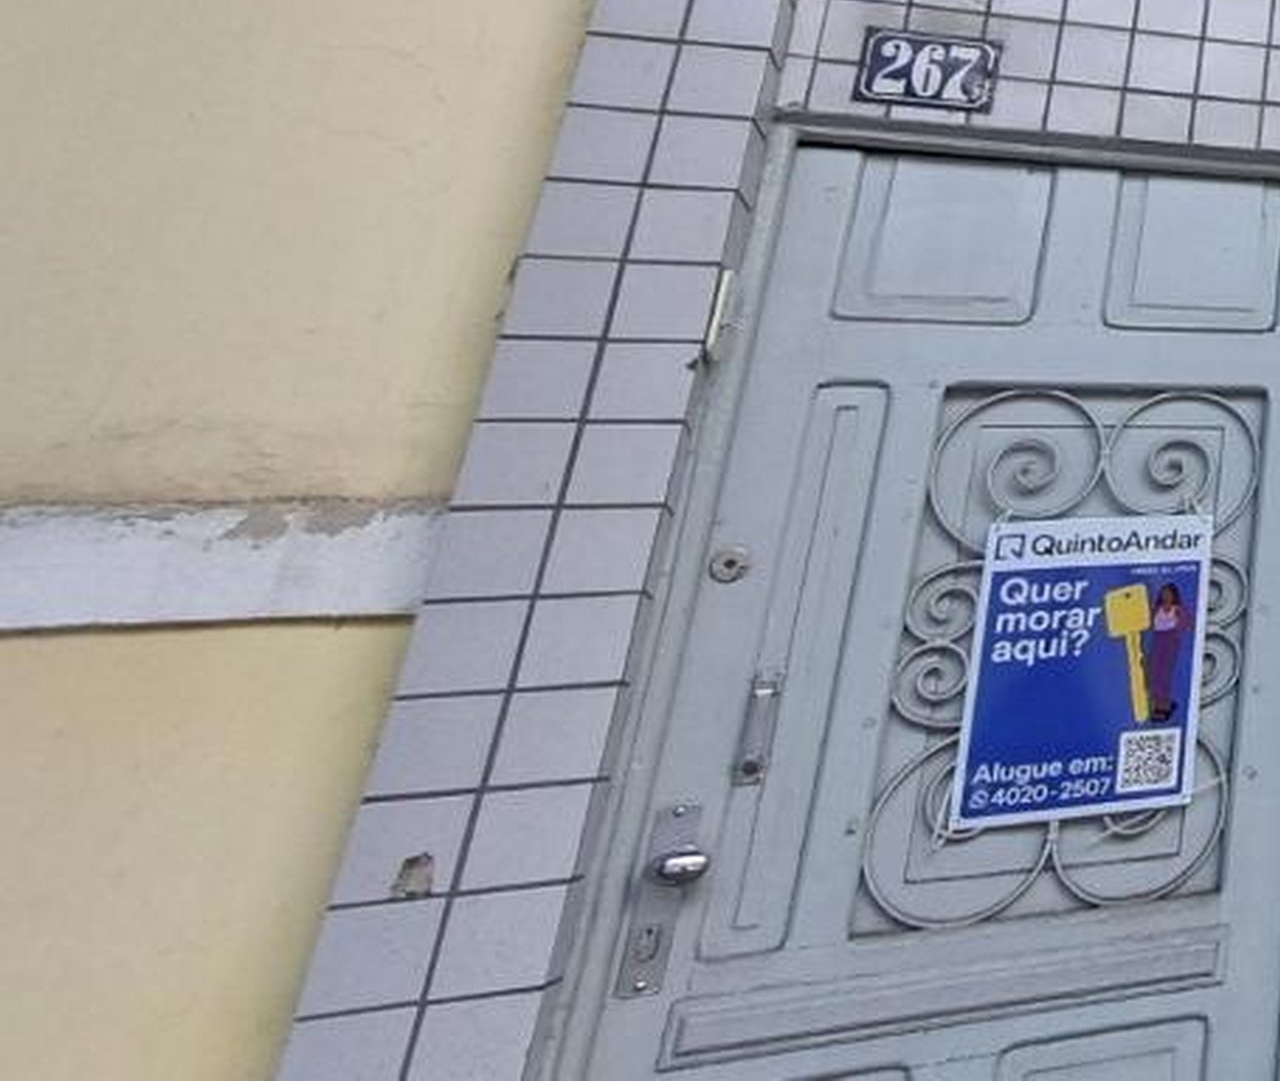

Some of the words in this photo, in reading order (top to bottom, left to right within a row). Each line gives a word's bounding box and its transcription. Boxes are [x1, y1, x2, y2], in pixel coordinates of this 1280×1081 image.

[871, 39, 981, 100] 267
[1031, 529, 1203, 556] QuintoAndar
[1000, 577, 1089, 606] Quer
[995, 606, 1102, 634] morar
[990, 629, 1090, 667] aqui?
[971, 760, 1063, 785] Alugue
[1069, 755, 1114, 776] em:
[989, 776, 1112, 806] 4020-2507
